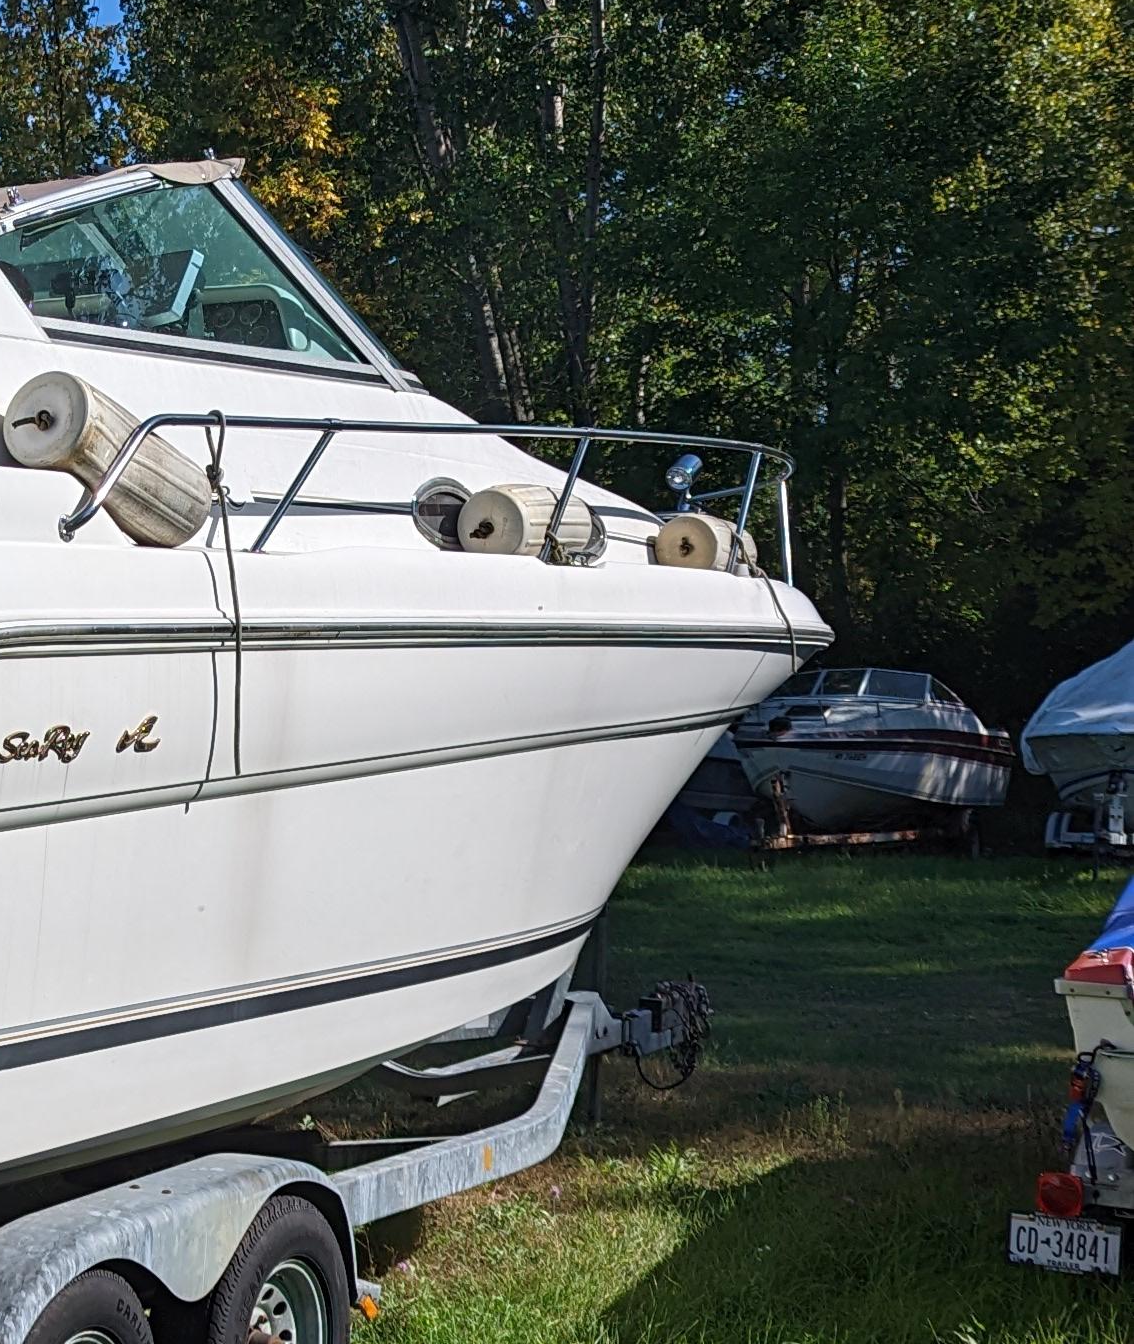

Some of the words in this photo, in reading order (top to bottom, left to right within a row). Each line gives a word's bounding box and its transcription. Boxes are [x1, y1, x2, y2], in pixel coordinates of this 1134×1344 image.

[1037, 1215, 1063, 1228] NEW
[1066, 1220, 1094, 1233] YORK
[1047, 1259, 1080, 1269] TRAILER
